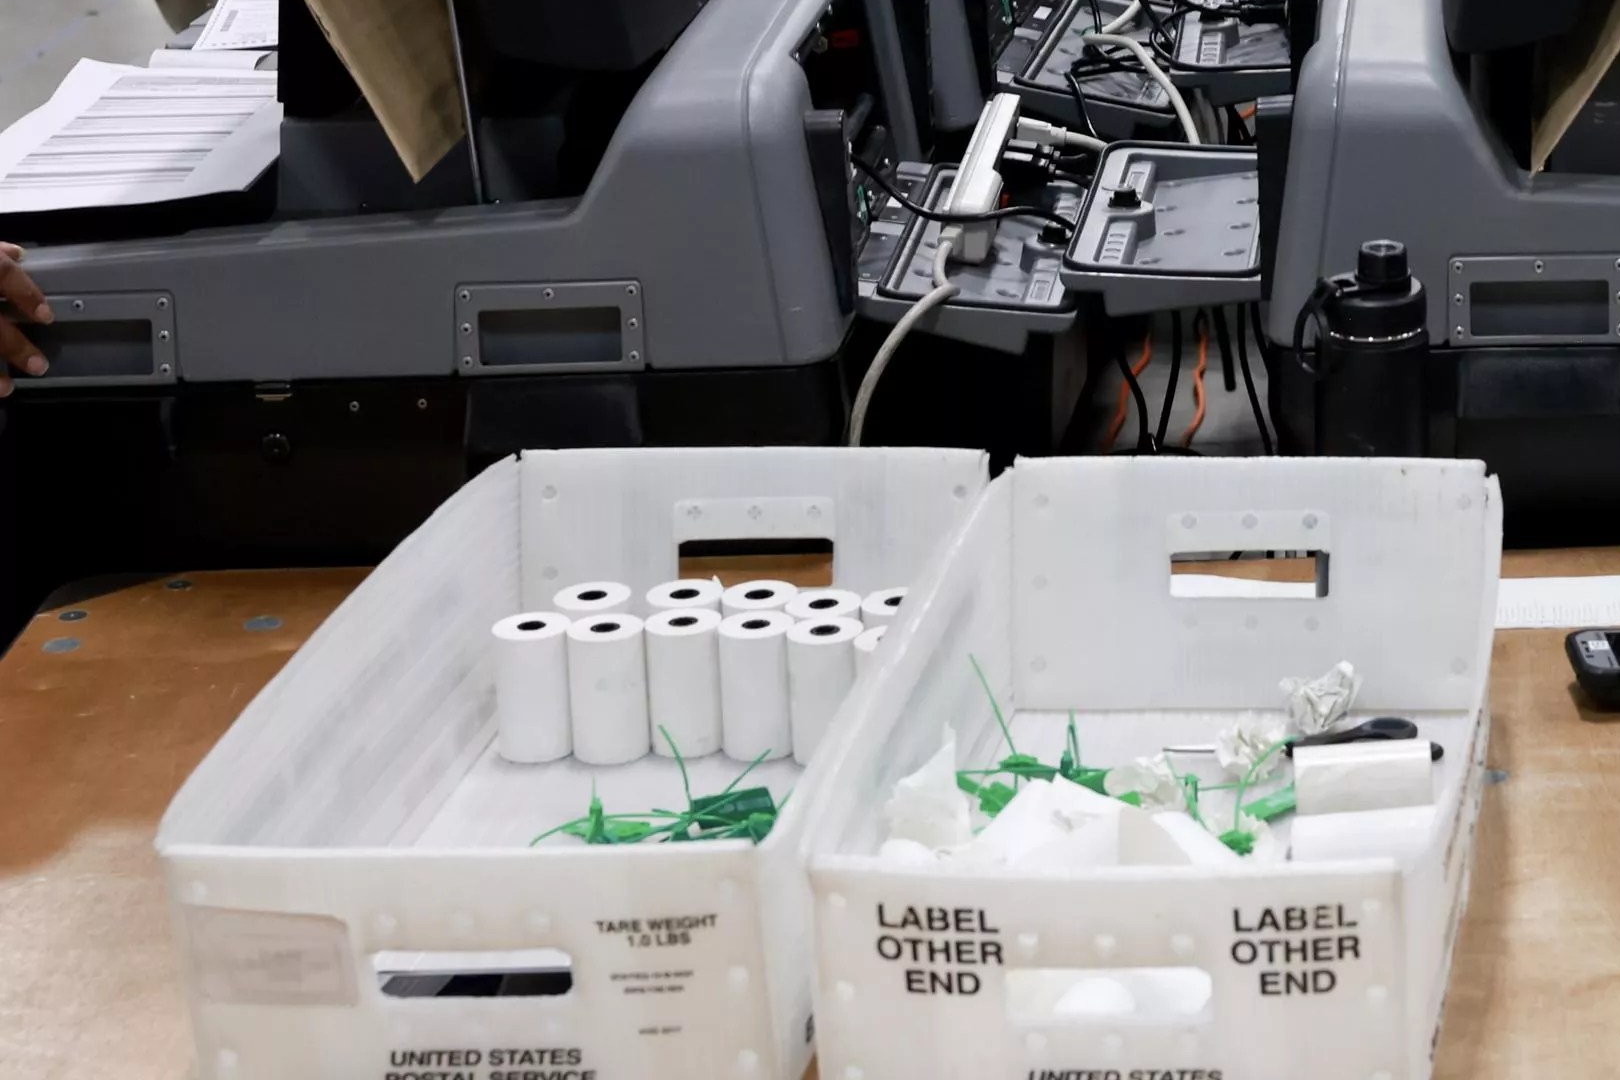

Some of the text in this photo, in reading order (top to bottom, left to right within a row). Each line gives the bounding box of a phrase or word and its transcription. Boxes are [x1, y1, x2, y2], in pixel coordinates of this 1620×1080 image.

[596, 913, 718, 934] TARE WEIGHT
[877, 902, 1000, 933] LABEL
[1232, 903, 1359, 933] LABEL
[627, 931, 692, 948] 1.0 LBS
[876, 934, 1004, 965] OTHER
[1231, 934, 1361, 965] OTHER
[905, 969, 982, 996] END
[1260, 968, 1337, 996] END
[390, 1048, 583, 1068] UNITED STATES
[1028, 1068, 1224, 1080] UNITED STATES
